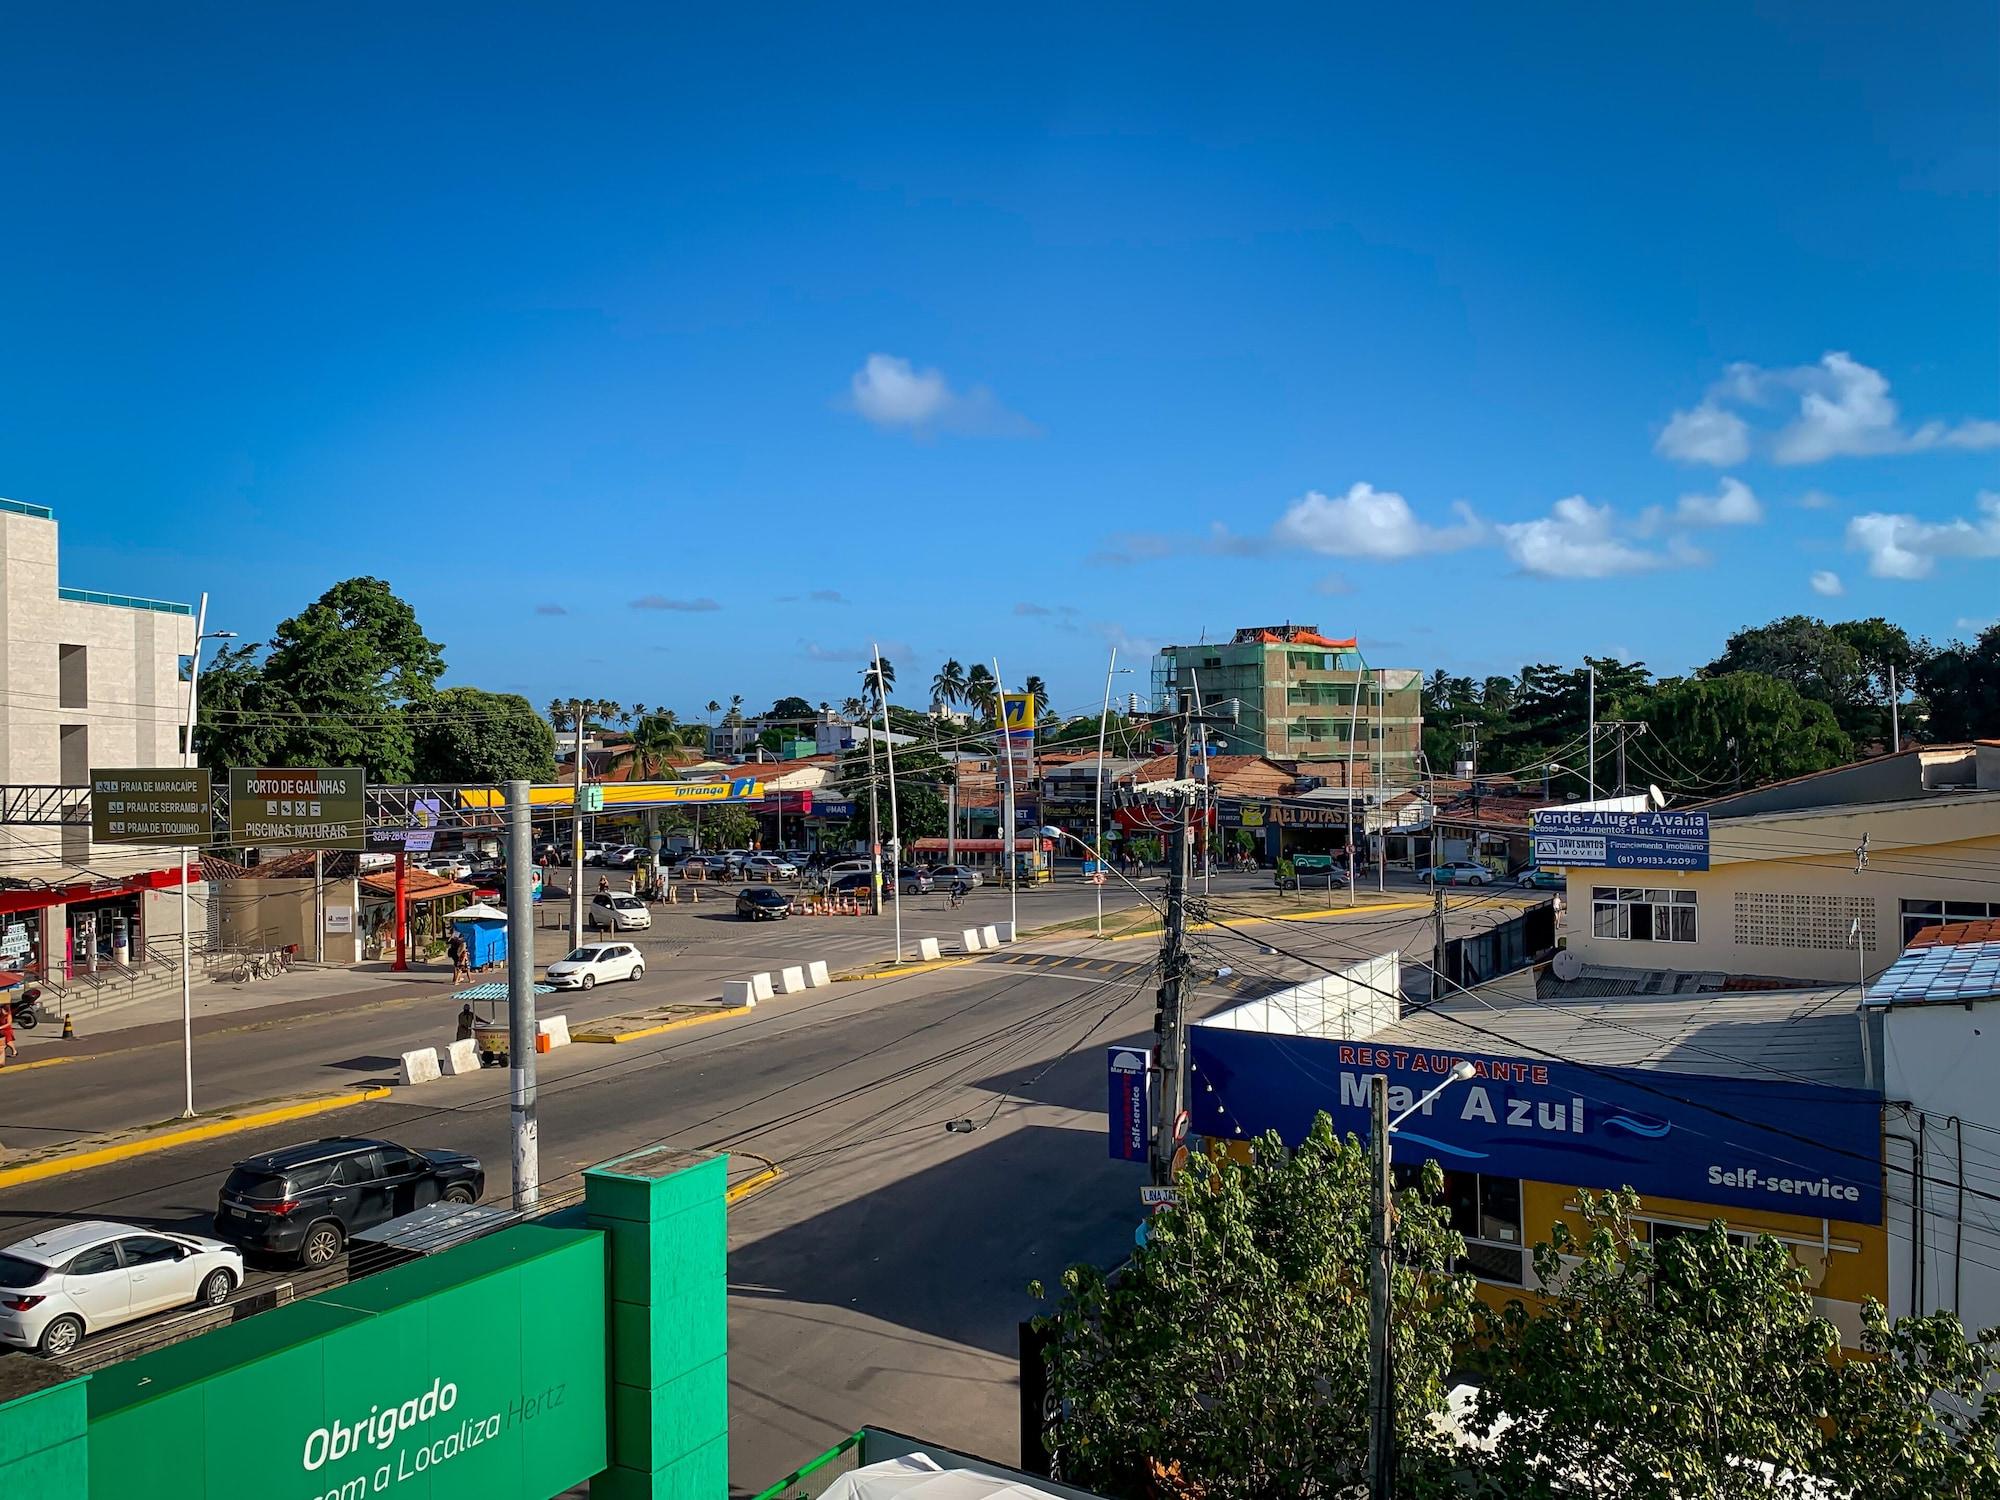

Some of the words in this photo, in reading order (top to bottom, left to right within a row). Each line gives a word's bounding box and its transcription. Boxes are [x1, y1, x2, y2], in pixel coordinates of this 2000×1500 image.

[120, 781, 142, 792] PRAIA
[144, 781, 153, 792] DE
[154, 779, 198, 792] MARACAÍPE
[247, 779, 280, 794] PORTO
[281, 780, 295, 794] DE
[295, 779, 346, 795] GALINHAS
[126, 802, 149, 813] PRAIA
[149, 802, 159, 813] DE
[160, 802, 199, 813] SERRAMBI
[1534, 811, 1582, 824] Vende
[1591, 812, 1638, 828] Aluga
[127, 822, 149, 833] PRAIA
[149, 823, 160, 833] DE
[160, 823, 200, 834] TOQUINHO
[245, 822, 292, 837] PISCINAS
[294, 824, 348, 839] NATURAIS
[1563, 824, 1626, 834] Apartamentos
[1631, 826, 1654, 835] Flats
[1660, 826, 1704, 836] Terrenos
[1576, 840, 1604, 849] SANTOS
[1610, 841, 1663, 850] Financiamento
[1617, 855, 1635, 865] (81)
[1636, 856, 1691, 865] 99133.4209
[1340, 1072, 1442, 1116] Mar
[1460, 1086, 1585, 1134] Azul
[1132, 1086, 1140, 1149] Self-service
[1708, 1165, 1860, 1202] Self-service
[303, 1377, 458, 1471] Obrigado
[373, 1463, 391, 1493] a
[397, 1412, 501, 1482] Localiza
[506, 1383, 566, 1430] Hertz
